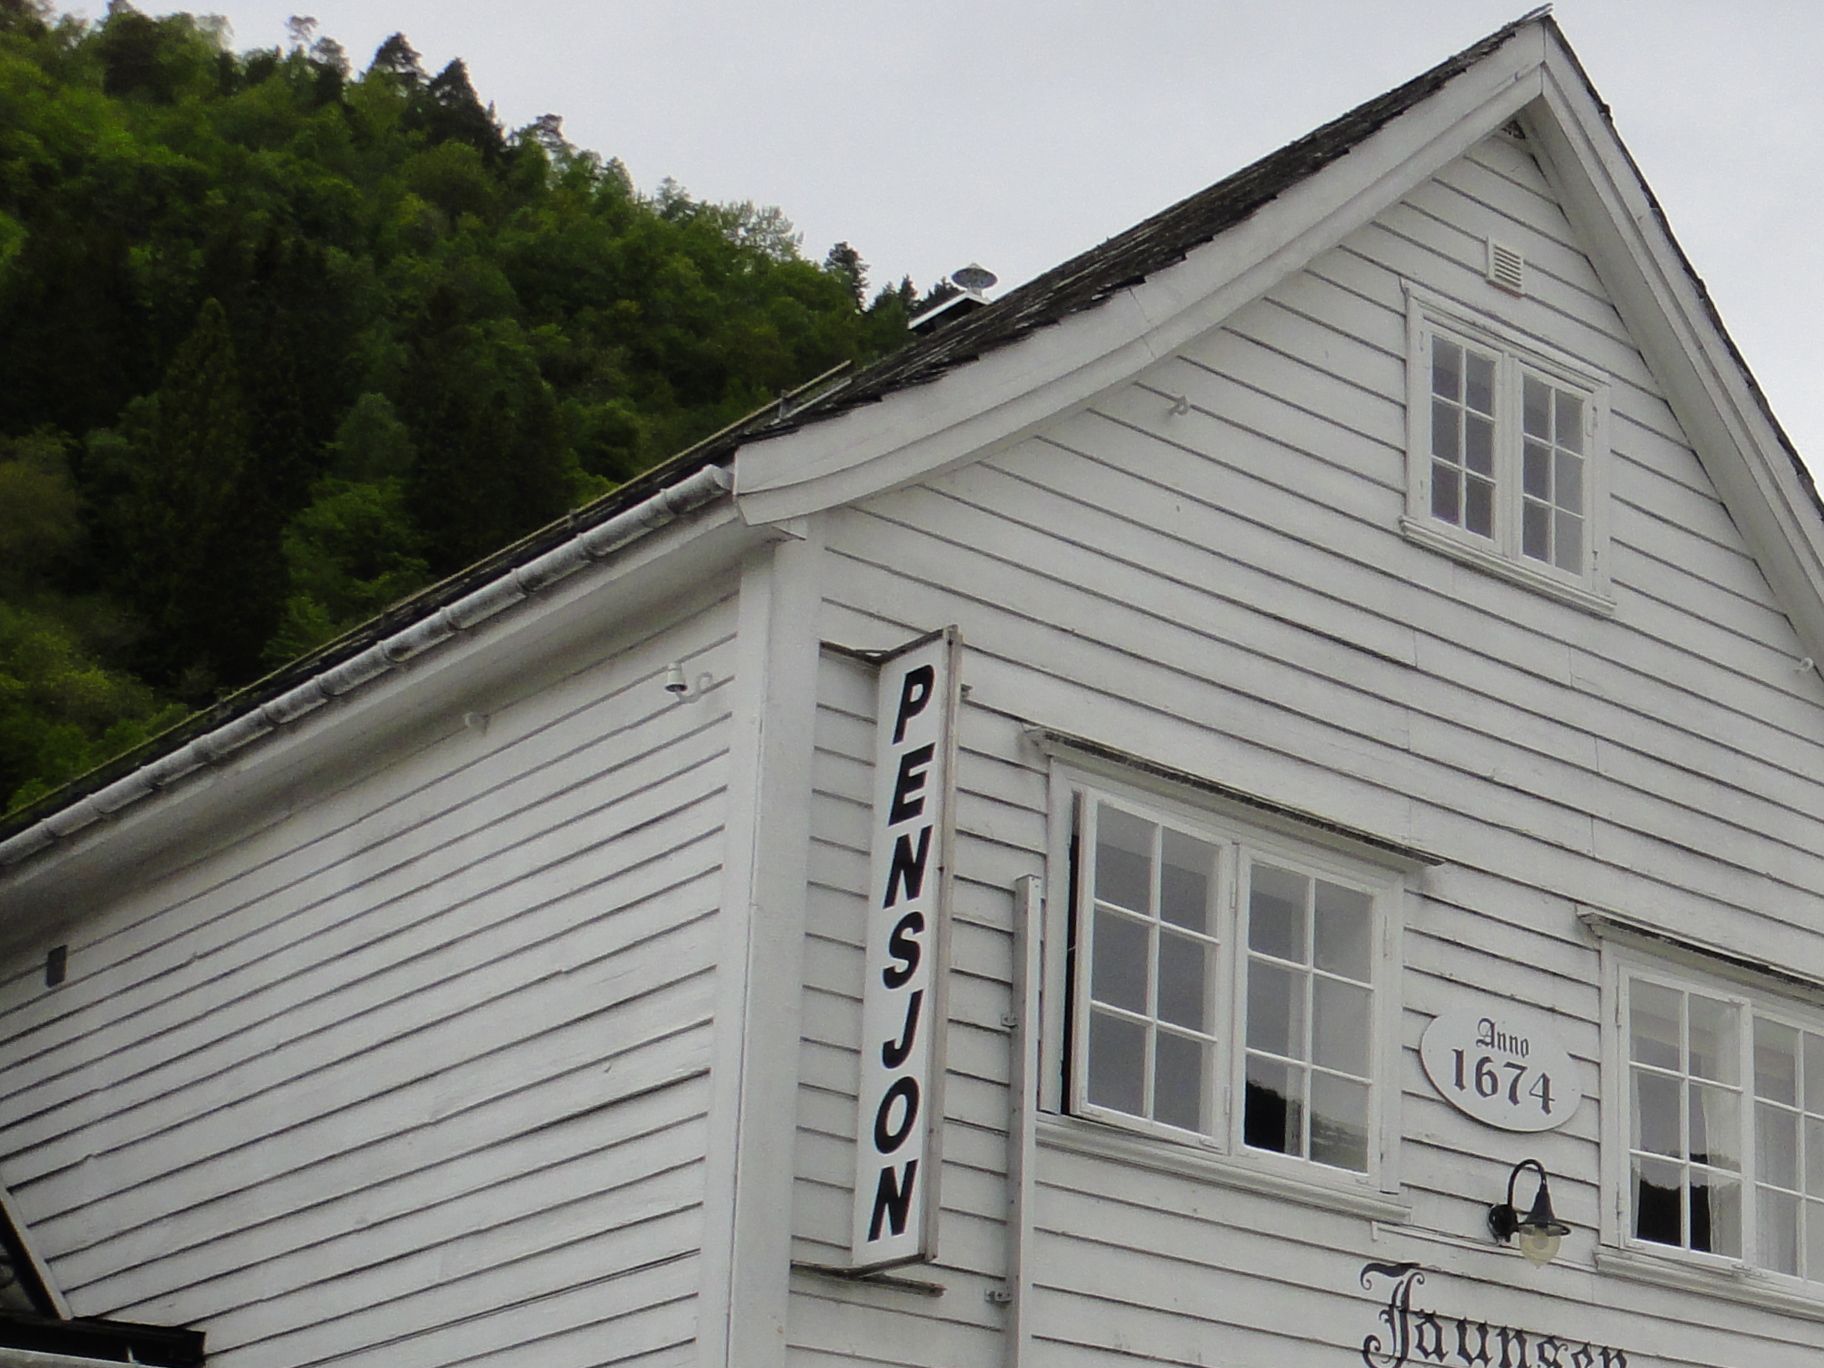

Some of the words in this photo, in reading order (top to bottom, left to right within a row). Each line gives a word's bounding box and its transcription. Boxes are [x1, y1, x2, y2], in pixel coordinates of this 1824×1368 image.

[866, 663, 936, 1244] PENSJON
[1475, 1017, 1531, 1057] Anno
[1451, 1047, 1556, 1117] 1674
